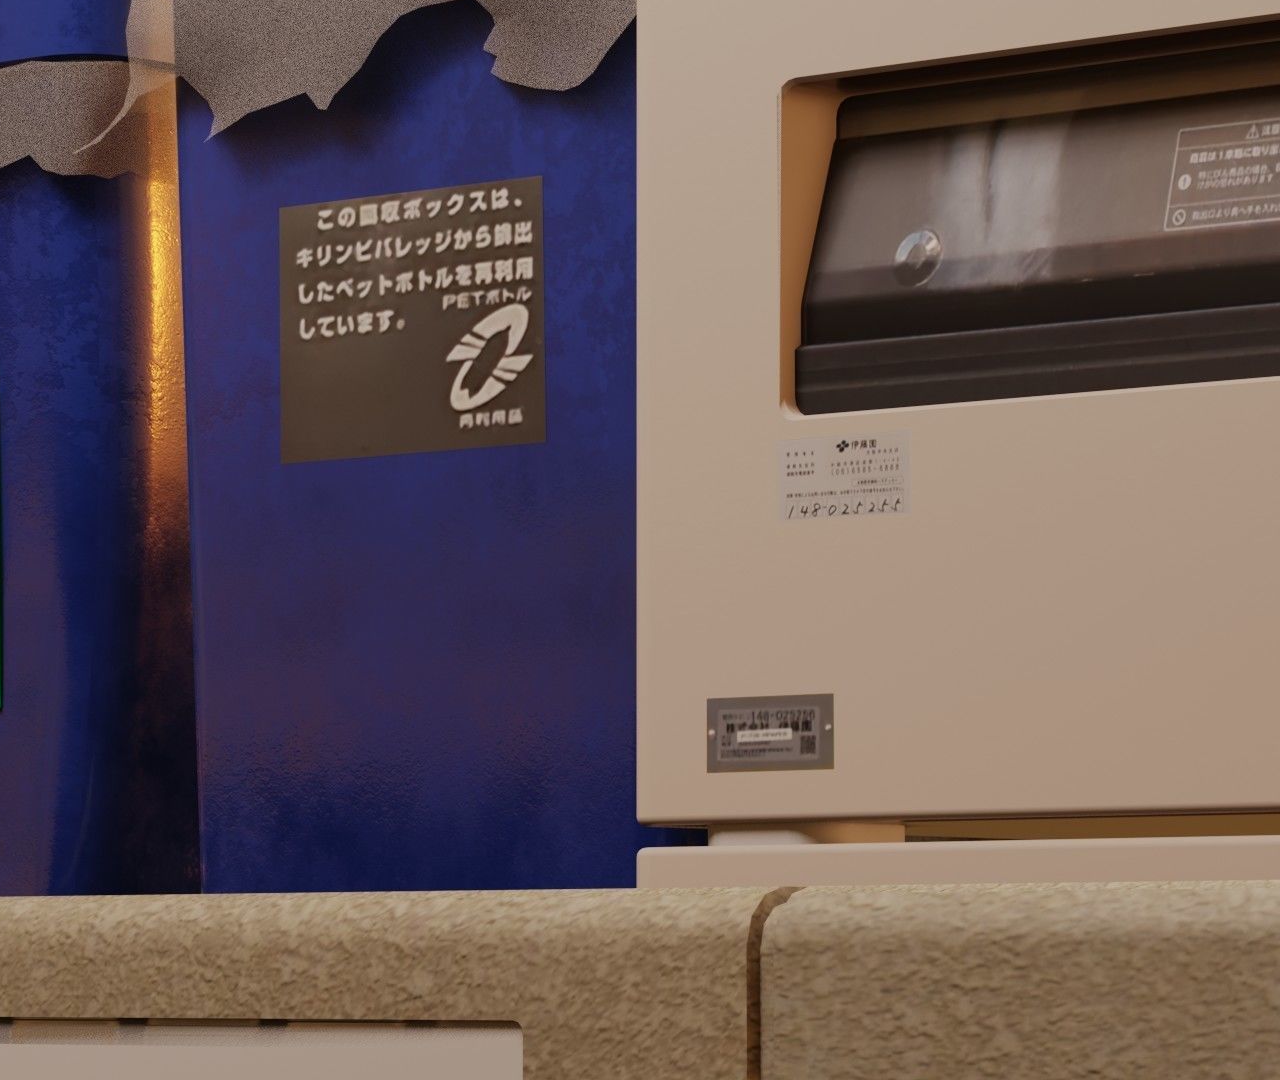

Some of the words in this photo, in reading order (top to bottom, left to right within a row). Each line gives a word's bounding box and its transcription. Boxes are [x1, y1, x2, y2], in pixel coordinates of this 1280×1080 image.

[316, 187, 523, 231] この回収ボックスは、
[441, 286, 533, 311] PETボトル
[299, 309, 406, 340] しています。
[787, 498, 901, 519] 148-025255
